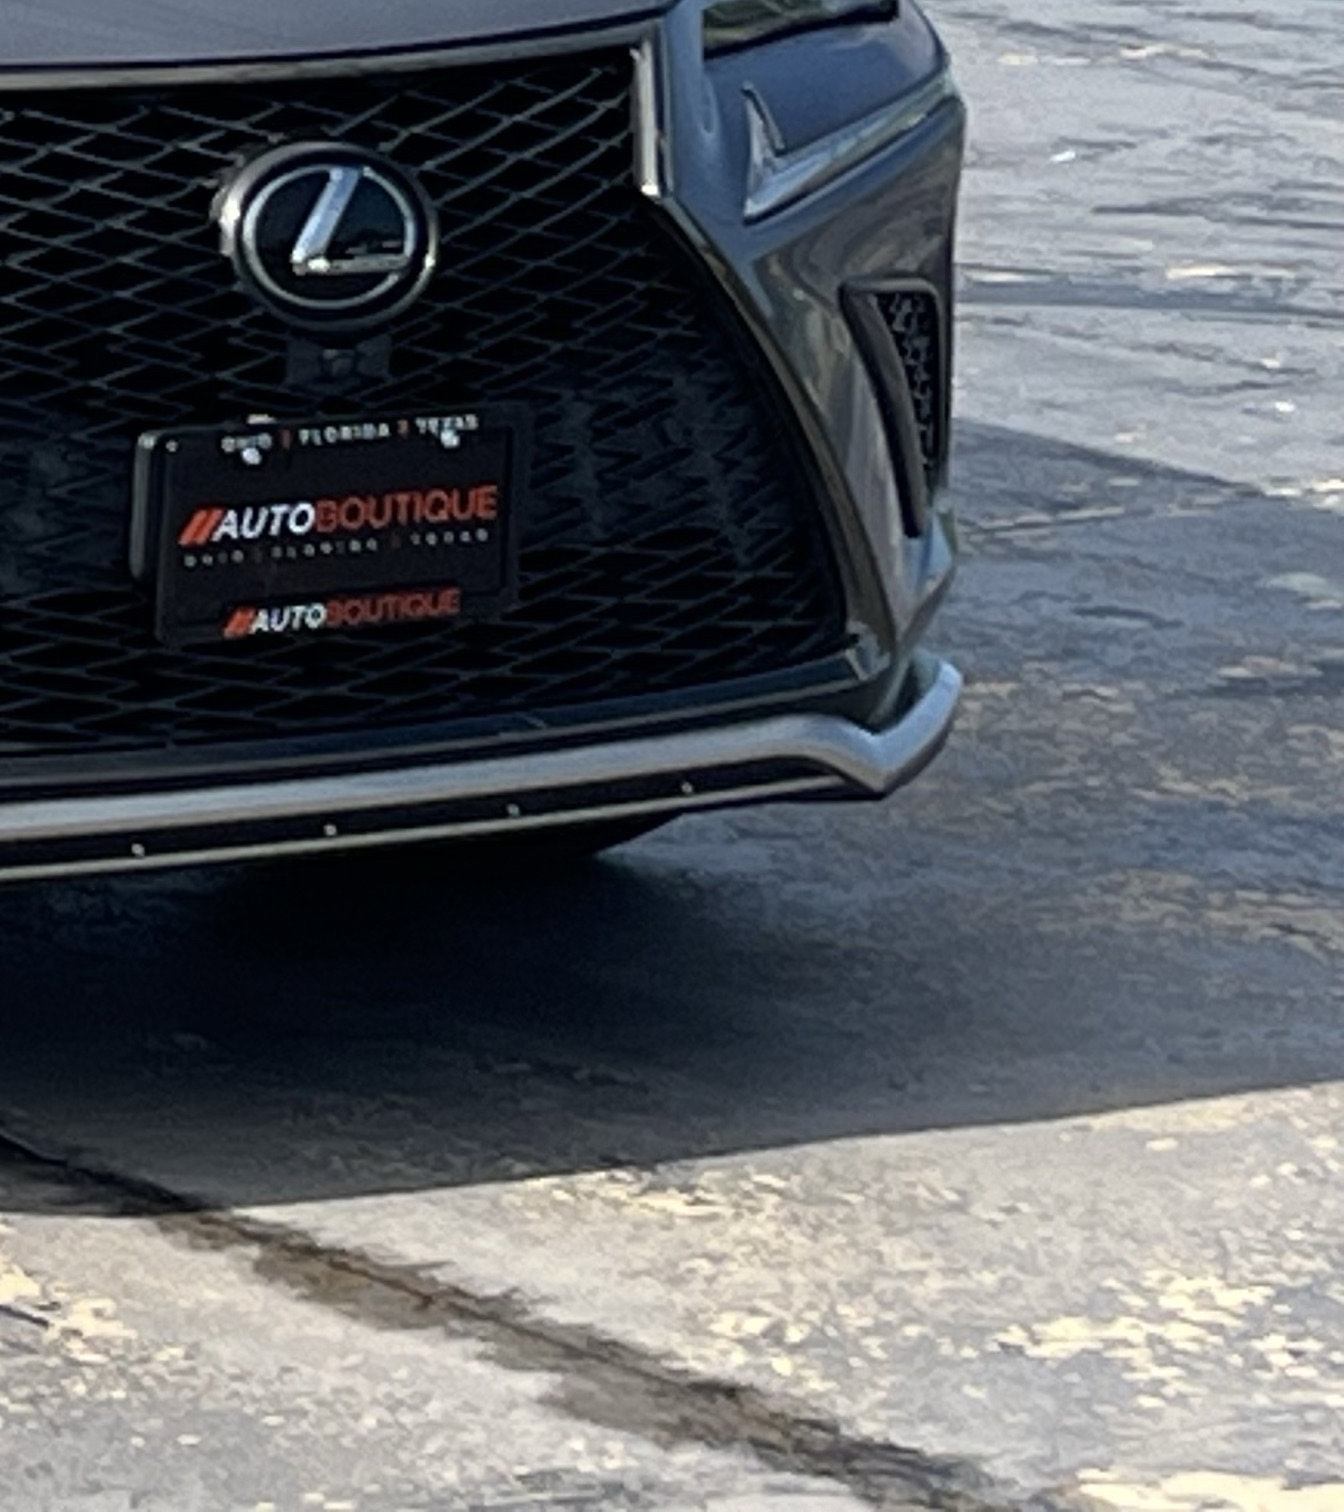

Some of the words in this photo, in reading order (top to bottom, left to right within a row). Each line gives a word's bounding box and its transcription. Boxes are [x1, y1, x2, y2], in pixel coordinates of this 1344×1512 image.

[298, 422, 391, 446] FLORIDA
[211, 485, 498, 543] AUTOBOUTIQUE
[248, 589, 461, 635] AUTOBOUTIQUE
